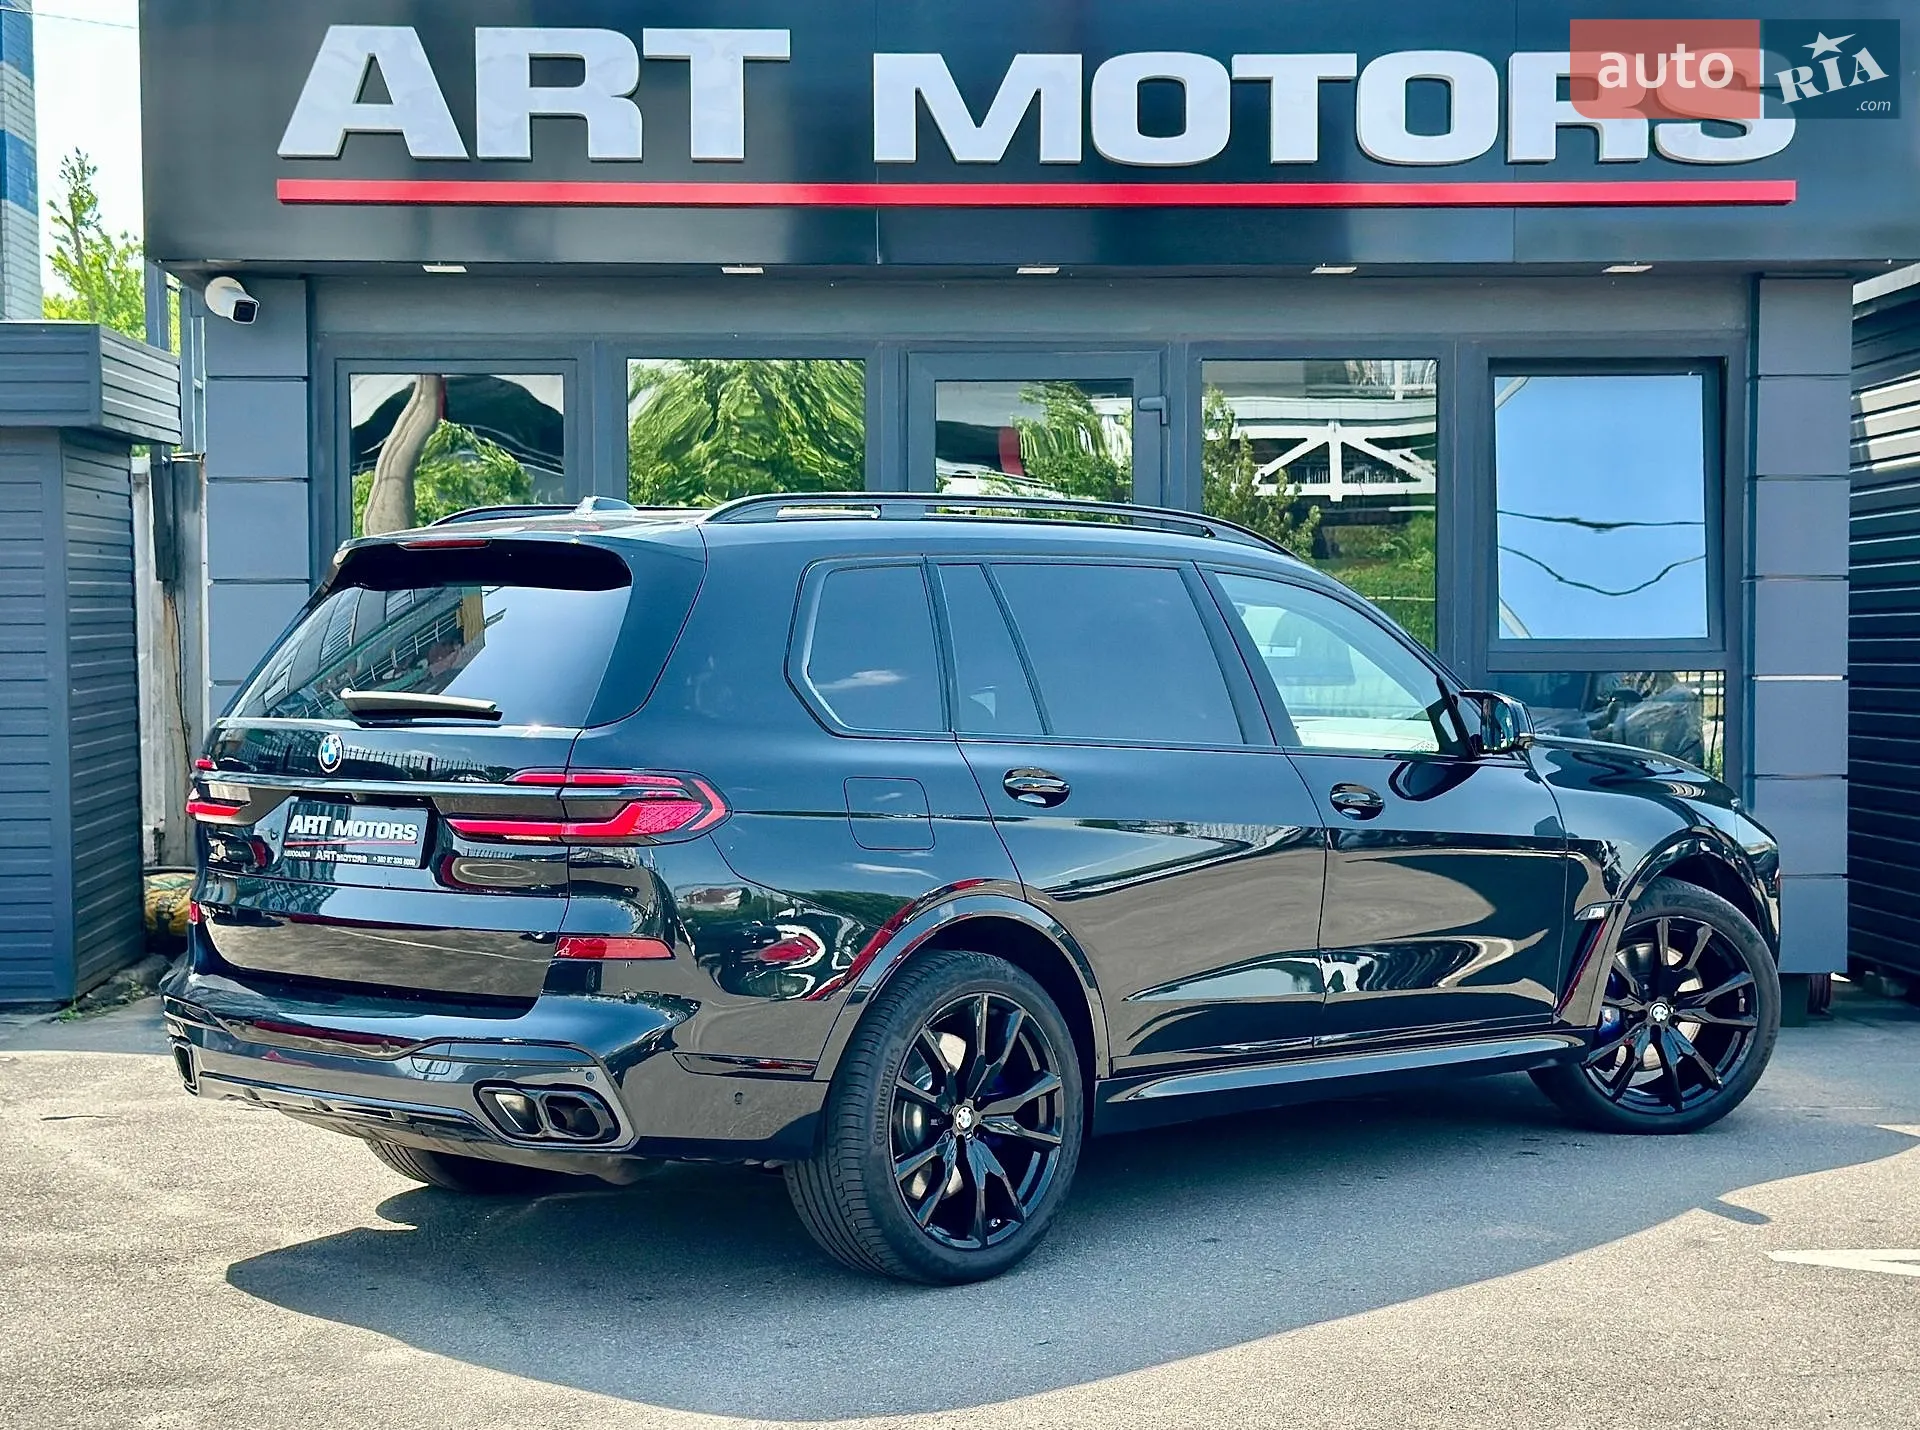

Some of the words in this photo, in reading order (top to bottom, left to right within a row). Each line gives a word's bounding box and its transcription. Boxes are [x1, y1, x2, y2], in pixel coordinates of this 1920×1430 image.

[276, 25, 791, 161] ART
[873, 48, 1797, 165] MOTORS
[287, 814, 332, 835] ART
[333, 819, 418, 841] MOTORS
